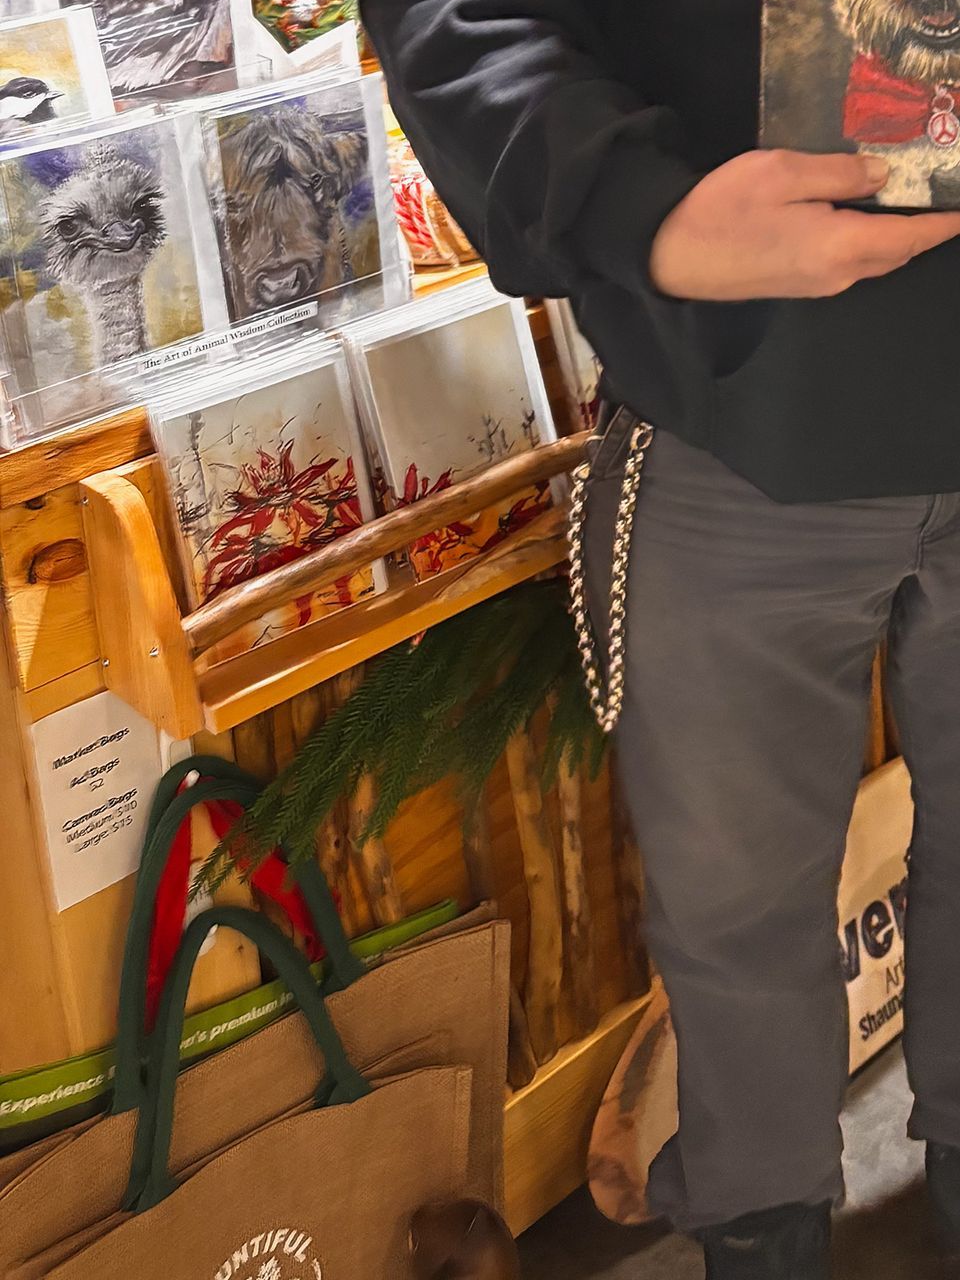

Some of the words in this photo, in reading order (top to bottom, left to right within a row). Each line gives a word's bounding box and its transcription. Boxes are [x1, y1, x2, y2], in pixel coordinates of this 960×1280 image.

[142, 358, 161, 370] The
[164, 352, 180, 363] Art
[181, 346, 194, 357] of
[195, 335, 229, 353] Animal
[230, 324, 266, 341] Wisdom
[266, 308, 312, 329] Collection
[858, 994, 904, 1041] Shaun
[0, 1073, 105, 1116] Experience
[208, 999, 278, 1042] premium
